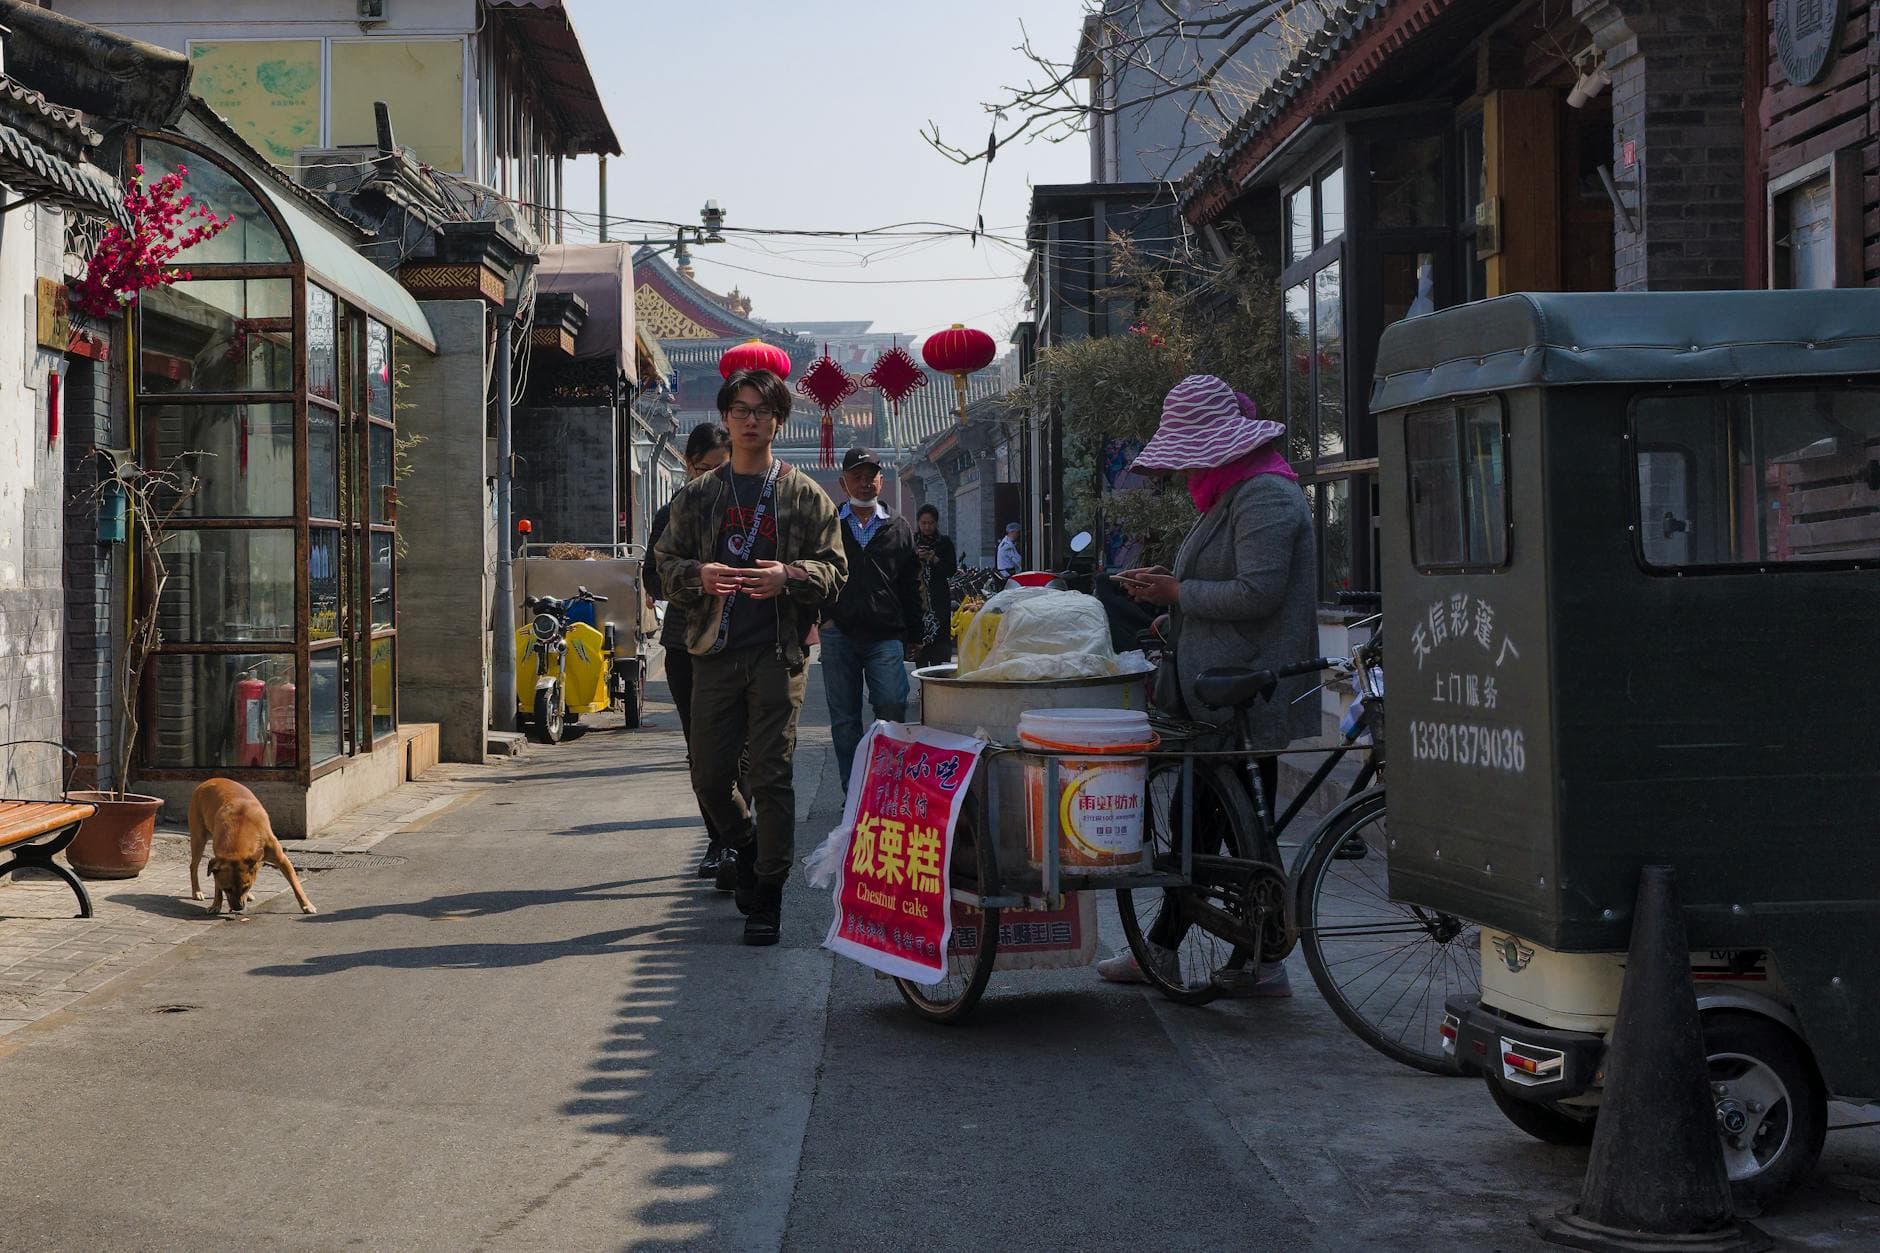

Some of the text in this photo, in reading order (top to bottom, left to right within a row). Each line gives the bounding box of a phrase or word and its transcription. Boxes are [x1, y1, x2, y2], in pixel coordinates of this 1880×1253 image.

[741, 504, 766, 560] SUPREME
[1432, 672, 1498, 709] 上门服务
[1411, 721, 1524, 771] 13381379036
[1079, 793, 1138, 811] 雨虹防水
[852, 811, 942, 894] 板栗糕
[857, 881, 929, 919] Chestnut cake
